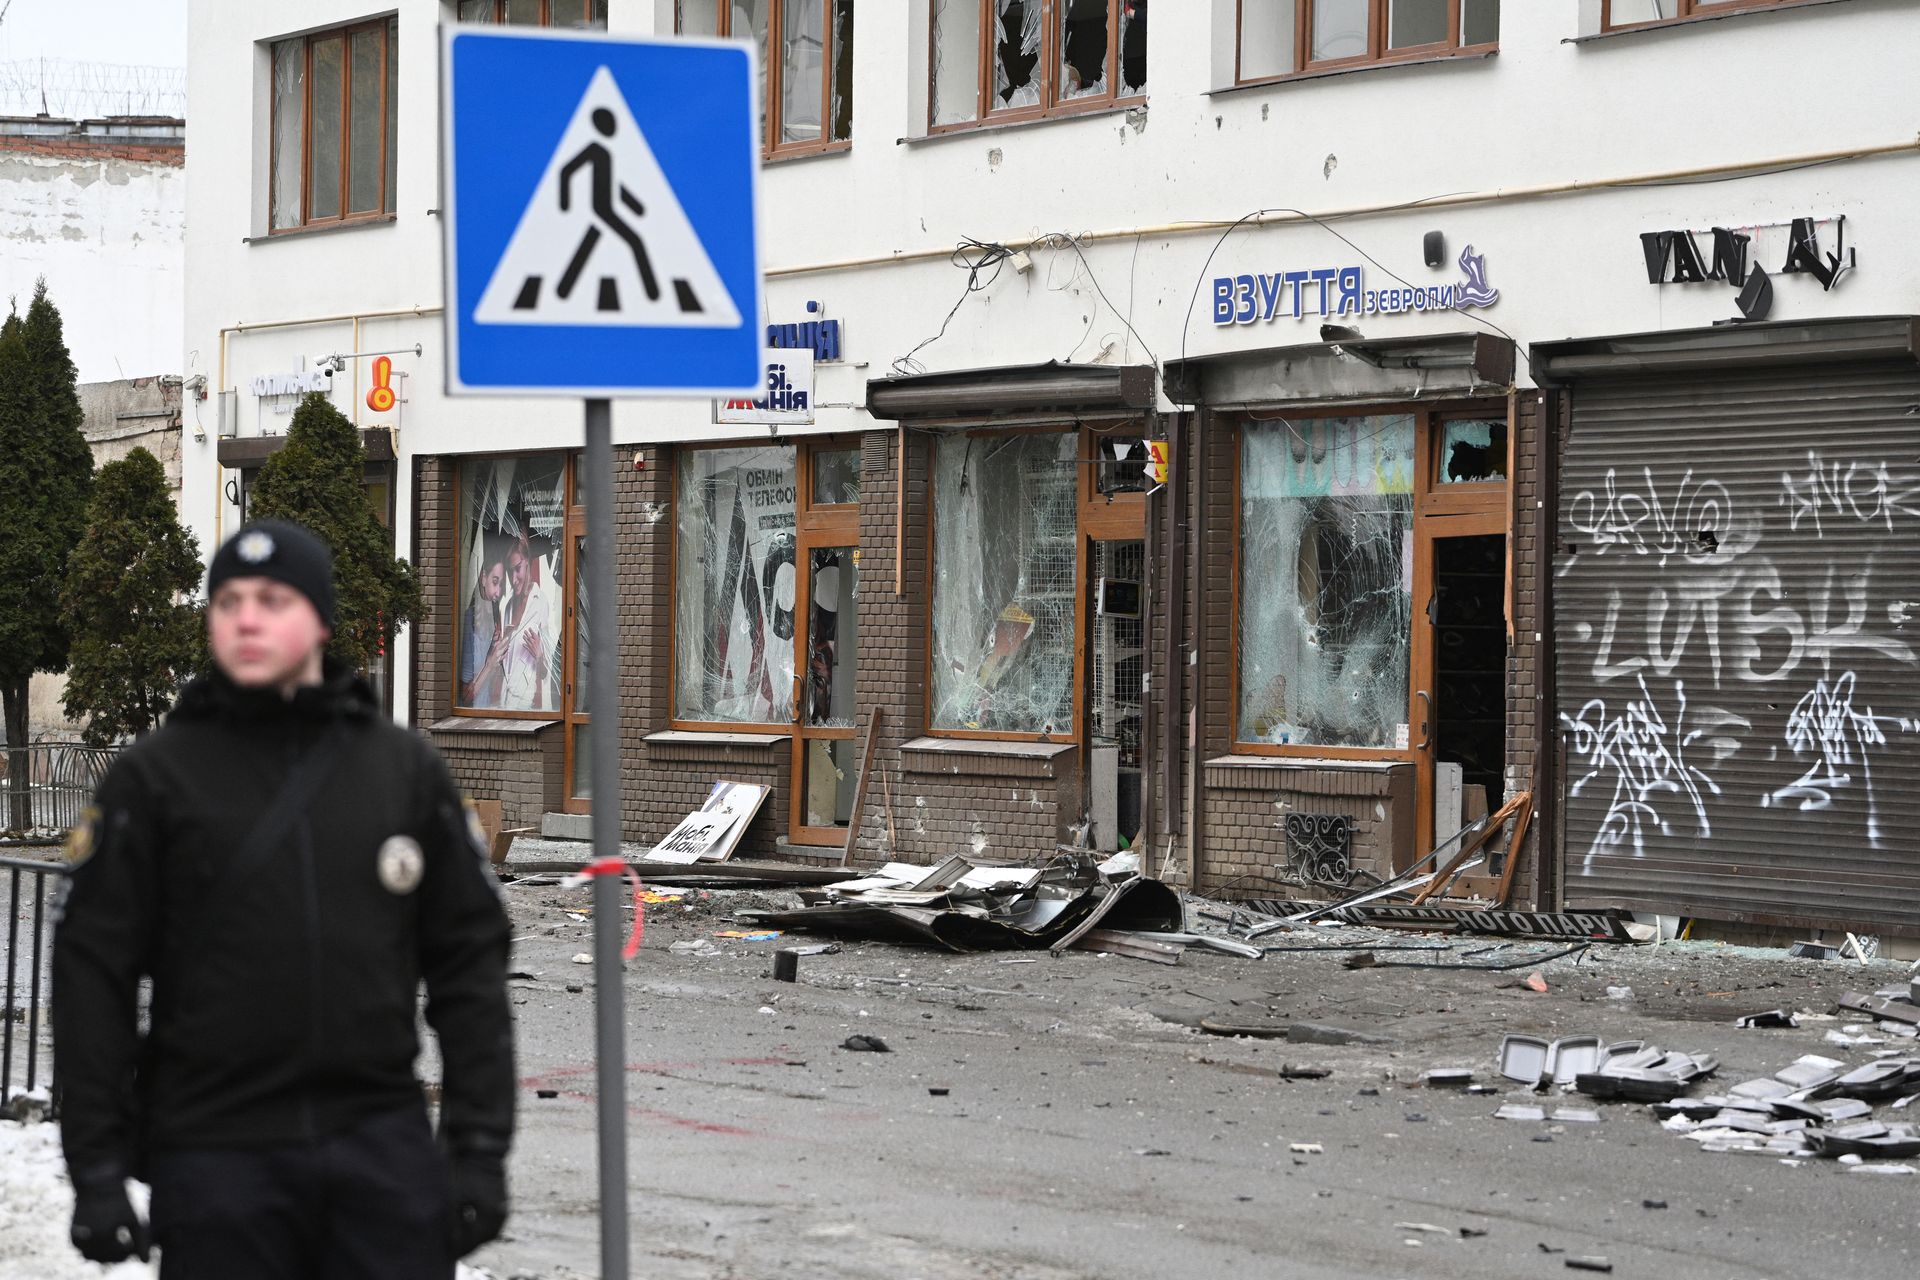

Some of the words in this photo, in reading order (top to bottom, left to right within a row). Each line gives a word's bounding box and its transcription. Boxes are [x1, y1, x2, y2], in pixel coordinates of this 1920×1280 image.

[1213, 266, 1363, 325] ВЗУТТЯ
[746, 469, 783, 488] ОБМІН
[1533, 914, 1615, 937] ПАРУ
